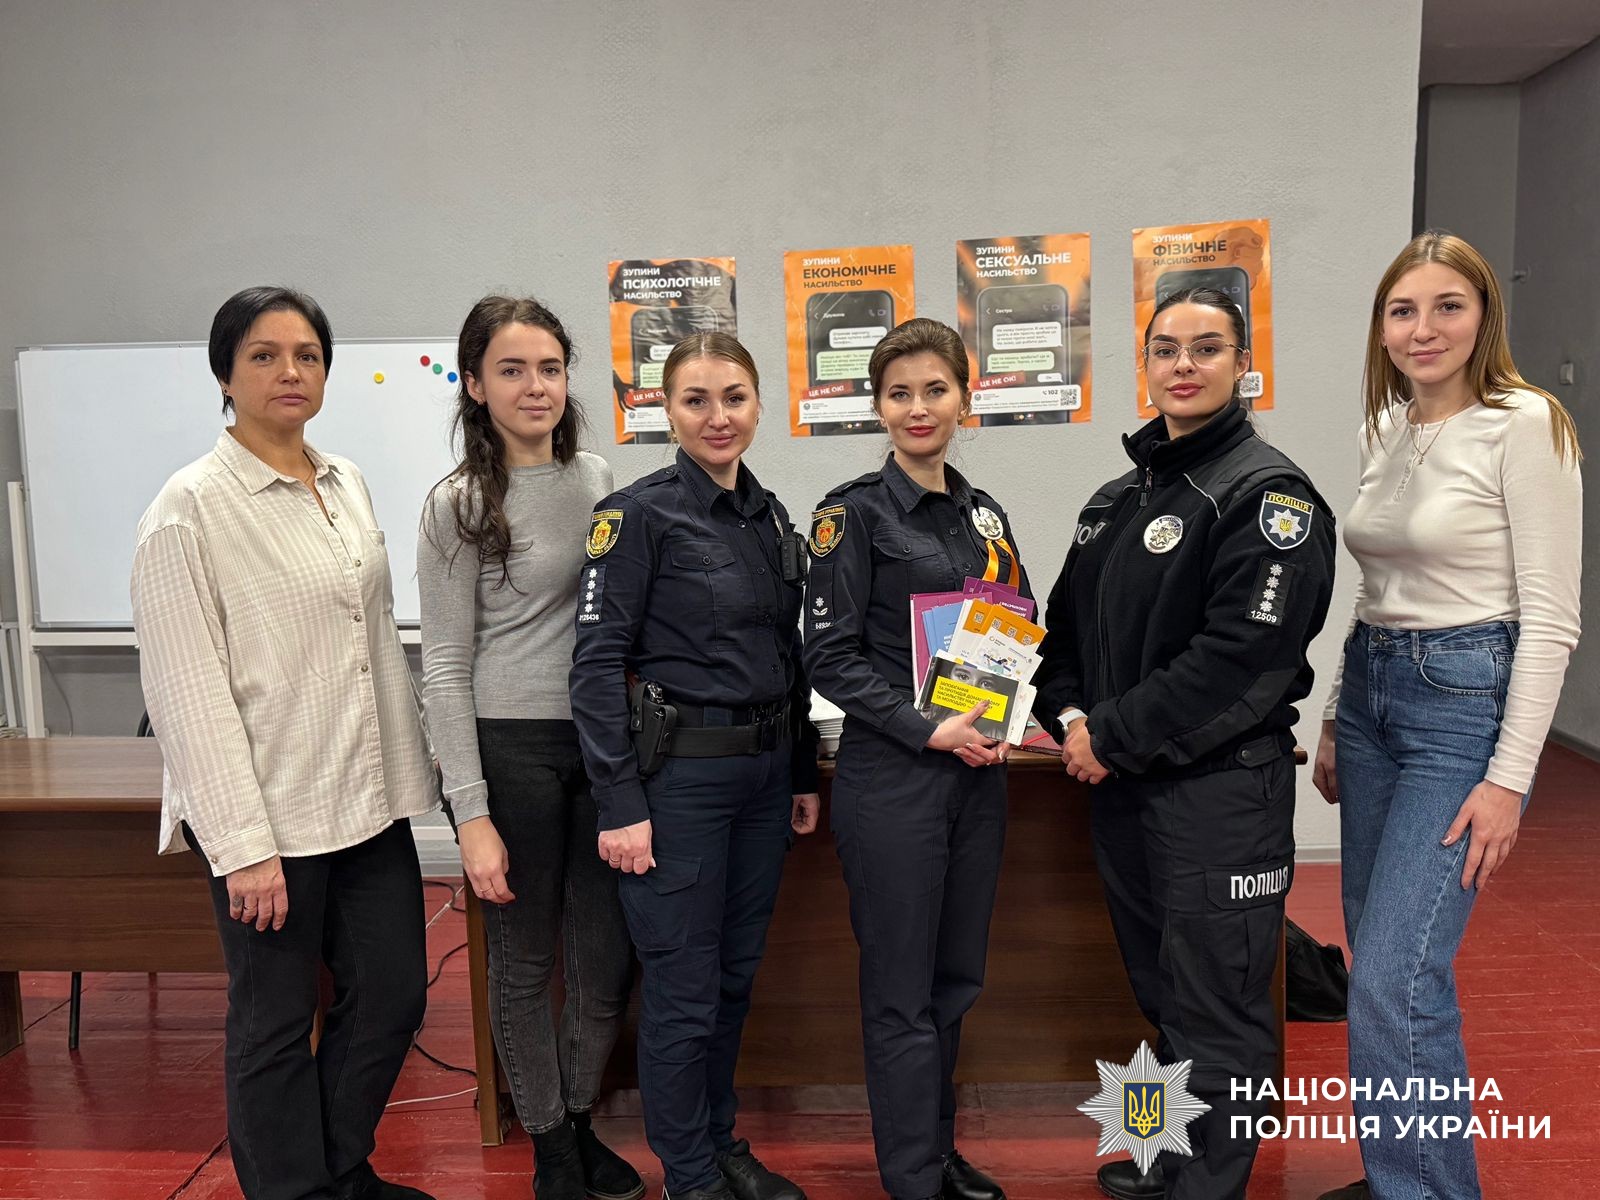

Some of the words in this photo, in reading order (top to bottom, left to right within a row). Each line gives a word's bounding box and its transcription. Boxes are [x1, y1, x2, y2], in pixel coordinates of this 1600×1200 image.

[1152, 233, 1193, 243] ЗУПИНИ
[976, 246, 1015, 255] ЗУПИНИ
[1153, 240, 1227, 257] ФІЗИЧНЕ
[802, 257, 841, 266] ЗУПИНИ
[976, 252, 1072, 269] СЕКСУАЛЬНЕ
[1153, 255, 1216, 266] НАСИЛЬСТВО
[623, 267, 660, 276] ЗУПИНИ
[803, 264, 897, 279] ЕКОНОМІЧНЕ
[976, 268, 1038, 278] НАСИЛЬСТВО
[623, 276, 722, 290] ПСИХОЛОГІЧНЕ
[803, 279, 863, 289] НАСИЛЬСТВО
[623, 291, 682, 300] НАСИЛЬСТВО
[980, 378, 991, 388] ЦЕ
[992, 377, 1003, 387] НЕ
[1003, 375, 1016, 385] ОК!
[633, 393, 644, 401] ЦЕ
[644, 392, 655, 400] НЕ
[808, 387, 819, 397] ЦЕ
[820, 386, 831, 396] НЕ
[831, 385, 844, 395] ОК!
[1268, 494, 1310, 512] ПОЛІЦІЯ
[1251, 610, 1277, 623] 12509
[1230, 866, 1289, 899] ПОЛІЦІЯ
